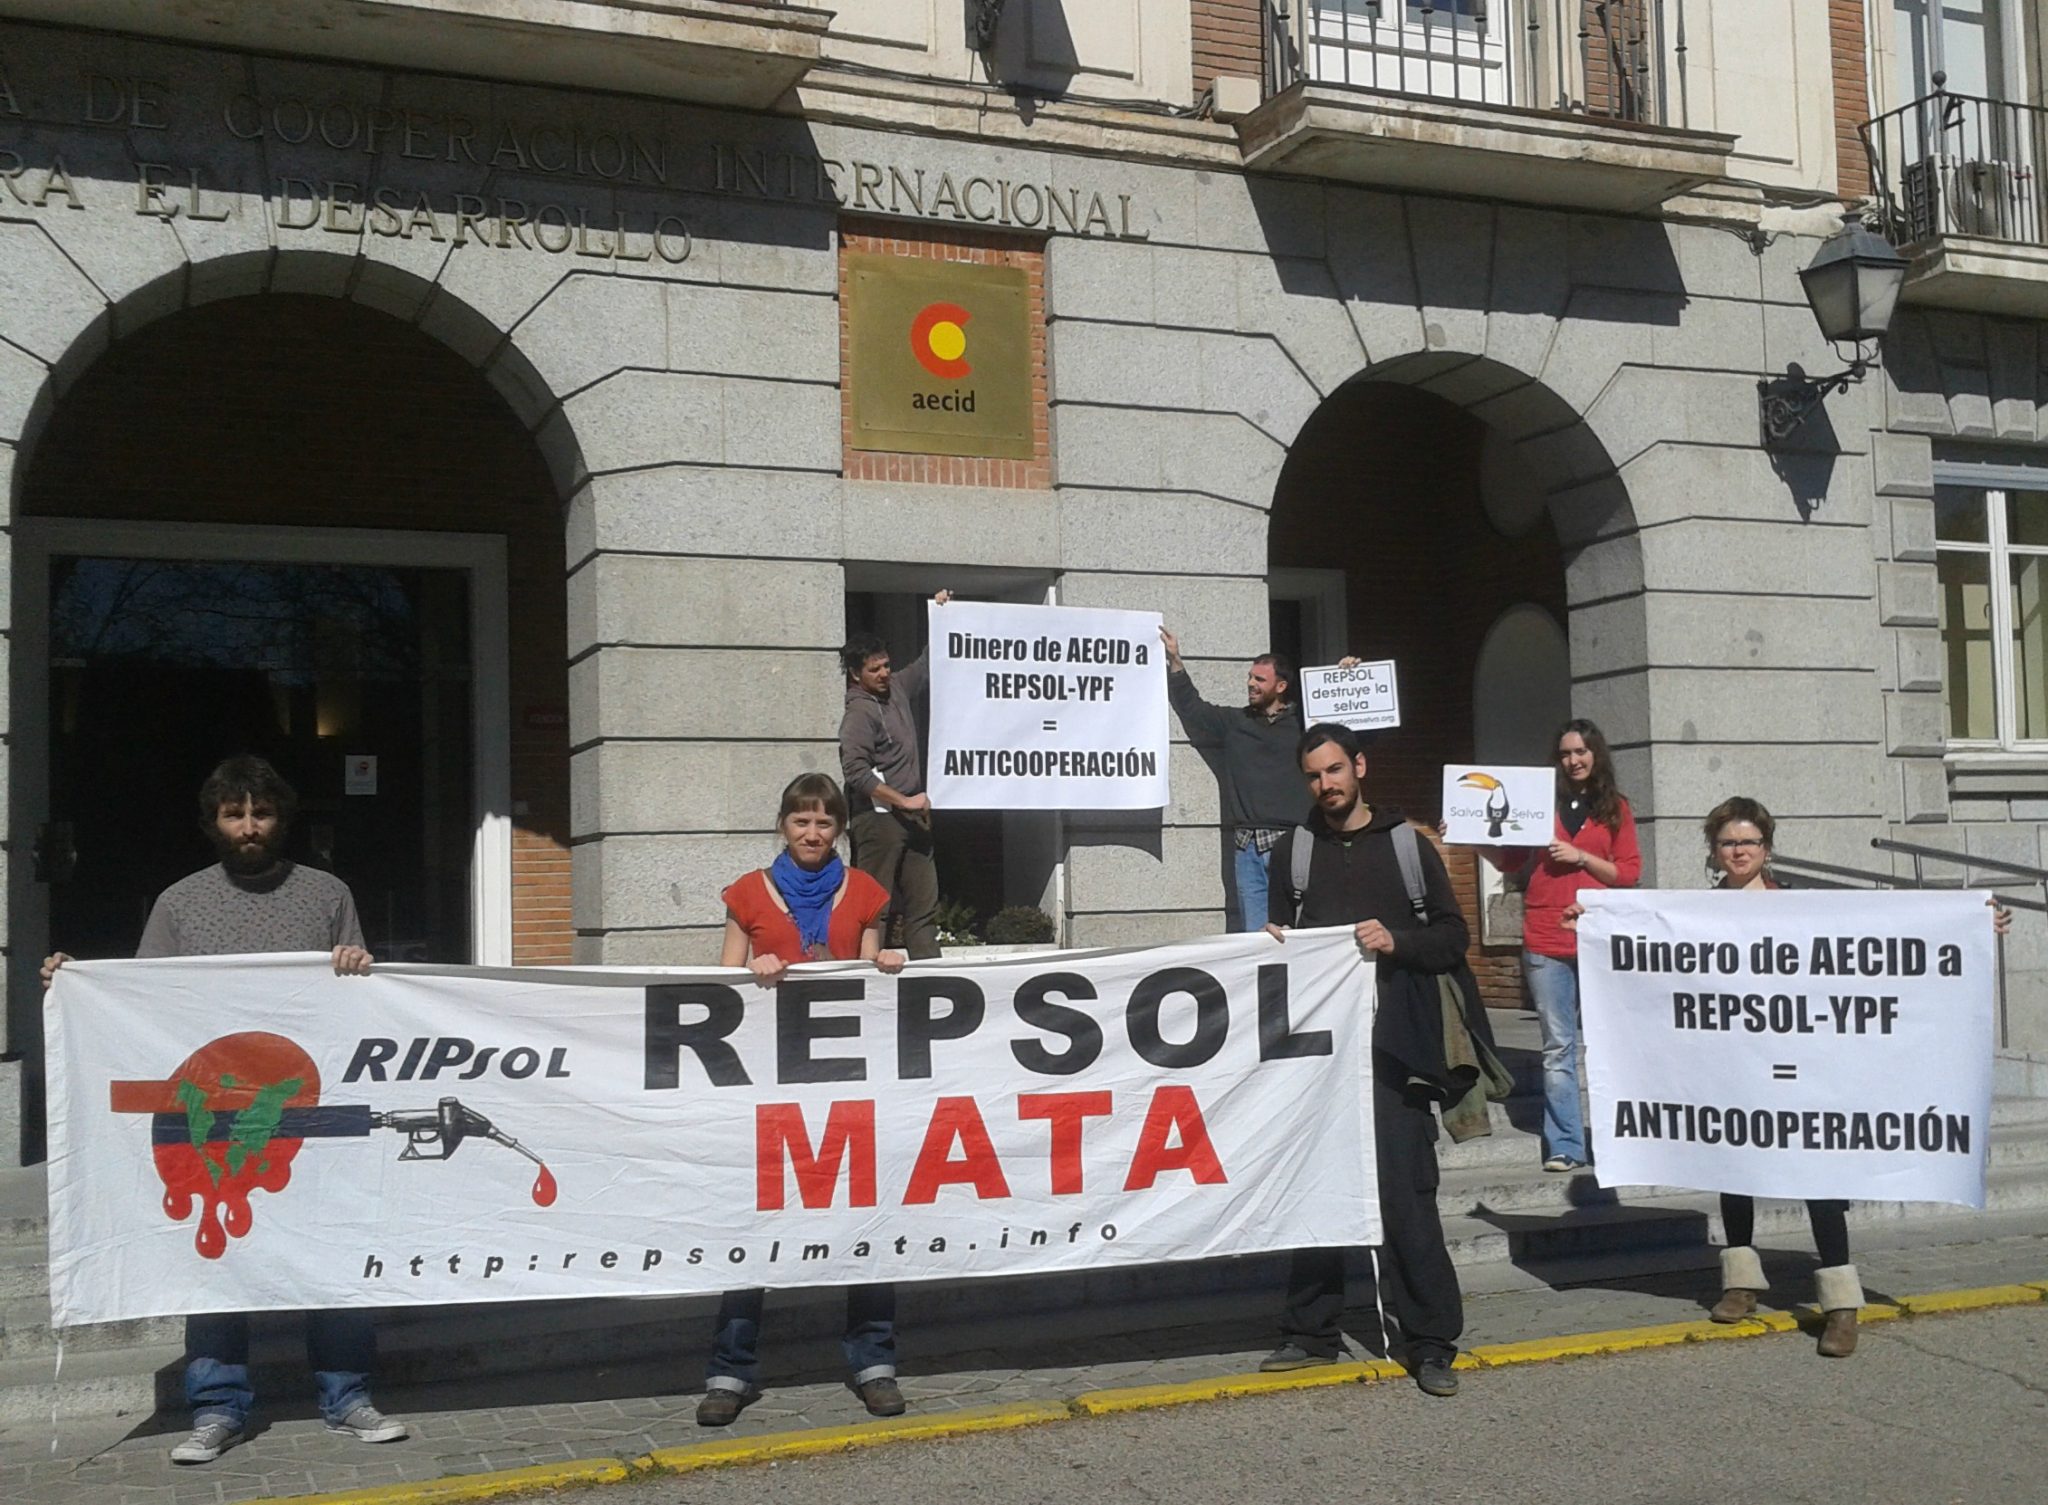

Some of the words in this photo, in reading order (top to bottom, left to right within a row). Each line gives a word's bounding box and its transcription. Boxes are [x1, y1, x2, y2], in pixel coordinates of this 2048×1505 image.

[83, 75, 171, 131] DE
[223, 94, 670, 185] COOPERACION
[711, 143, 1150, 241] INTERNACIONAL
[133, 163, 229, 222] EL
[273, 177, 692, 264] DESARROLLO
[912, 390, 976, 413] aecid
[948, 632, 1028, 661] Dinero
[1033, 636, 1062, 662] de
[1066, 637, 1130, 665] AECID
[1135, 644, 1148, 665] a
[986, 672, 1114, 701] REPSOL-YPF
[1311, 686, 1371, 699] destruye
[1375, 683, 1388, 693] la
[1322, 669, 1374, 684] REPSOL
[1333, 699, 1369, 712] selva
[944, 747, 1157, 777] ANTICOOPERACIÓN
[1449, 806, 1484, 818] Salva
[1491, 809, 1503, 818] la
[1511, 808, 1545, 820] Selva
[1611, 935, 1740, 974] Dinero
[1750, 937, 1799, 976] de
[1809, 937, 1926, 977] AECID
[1938, 944, 1962, 977] a
[644, 963, 1333, 1090] REPSOL
[1673, 992, 1899, 1035] REPSOL-YPF
[1614, 1101, 1970, 1154] ANTICOOPERACIÓN
[756, 1085, 1228, 1212] MATA
